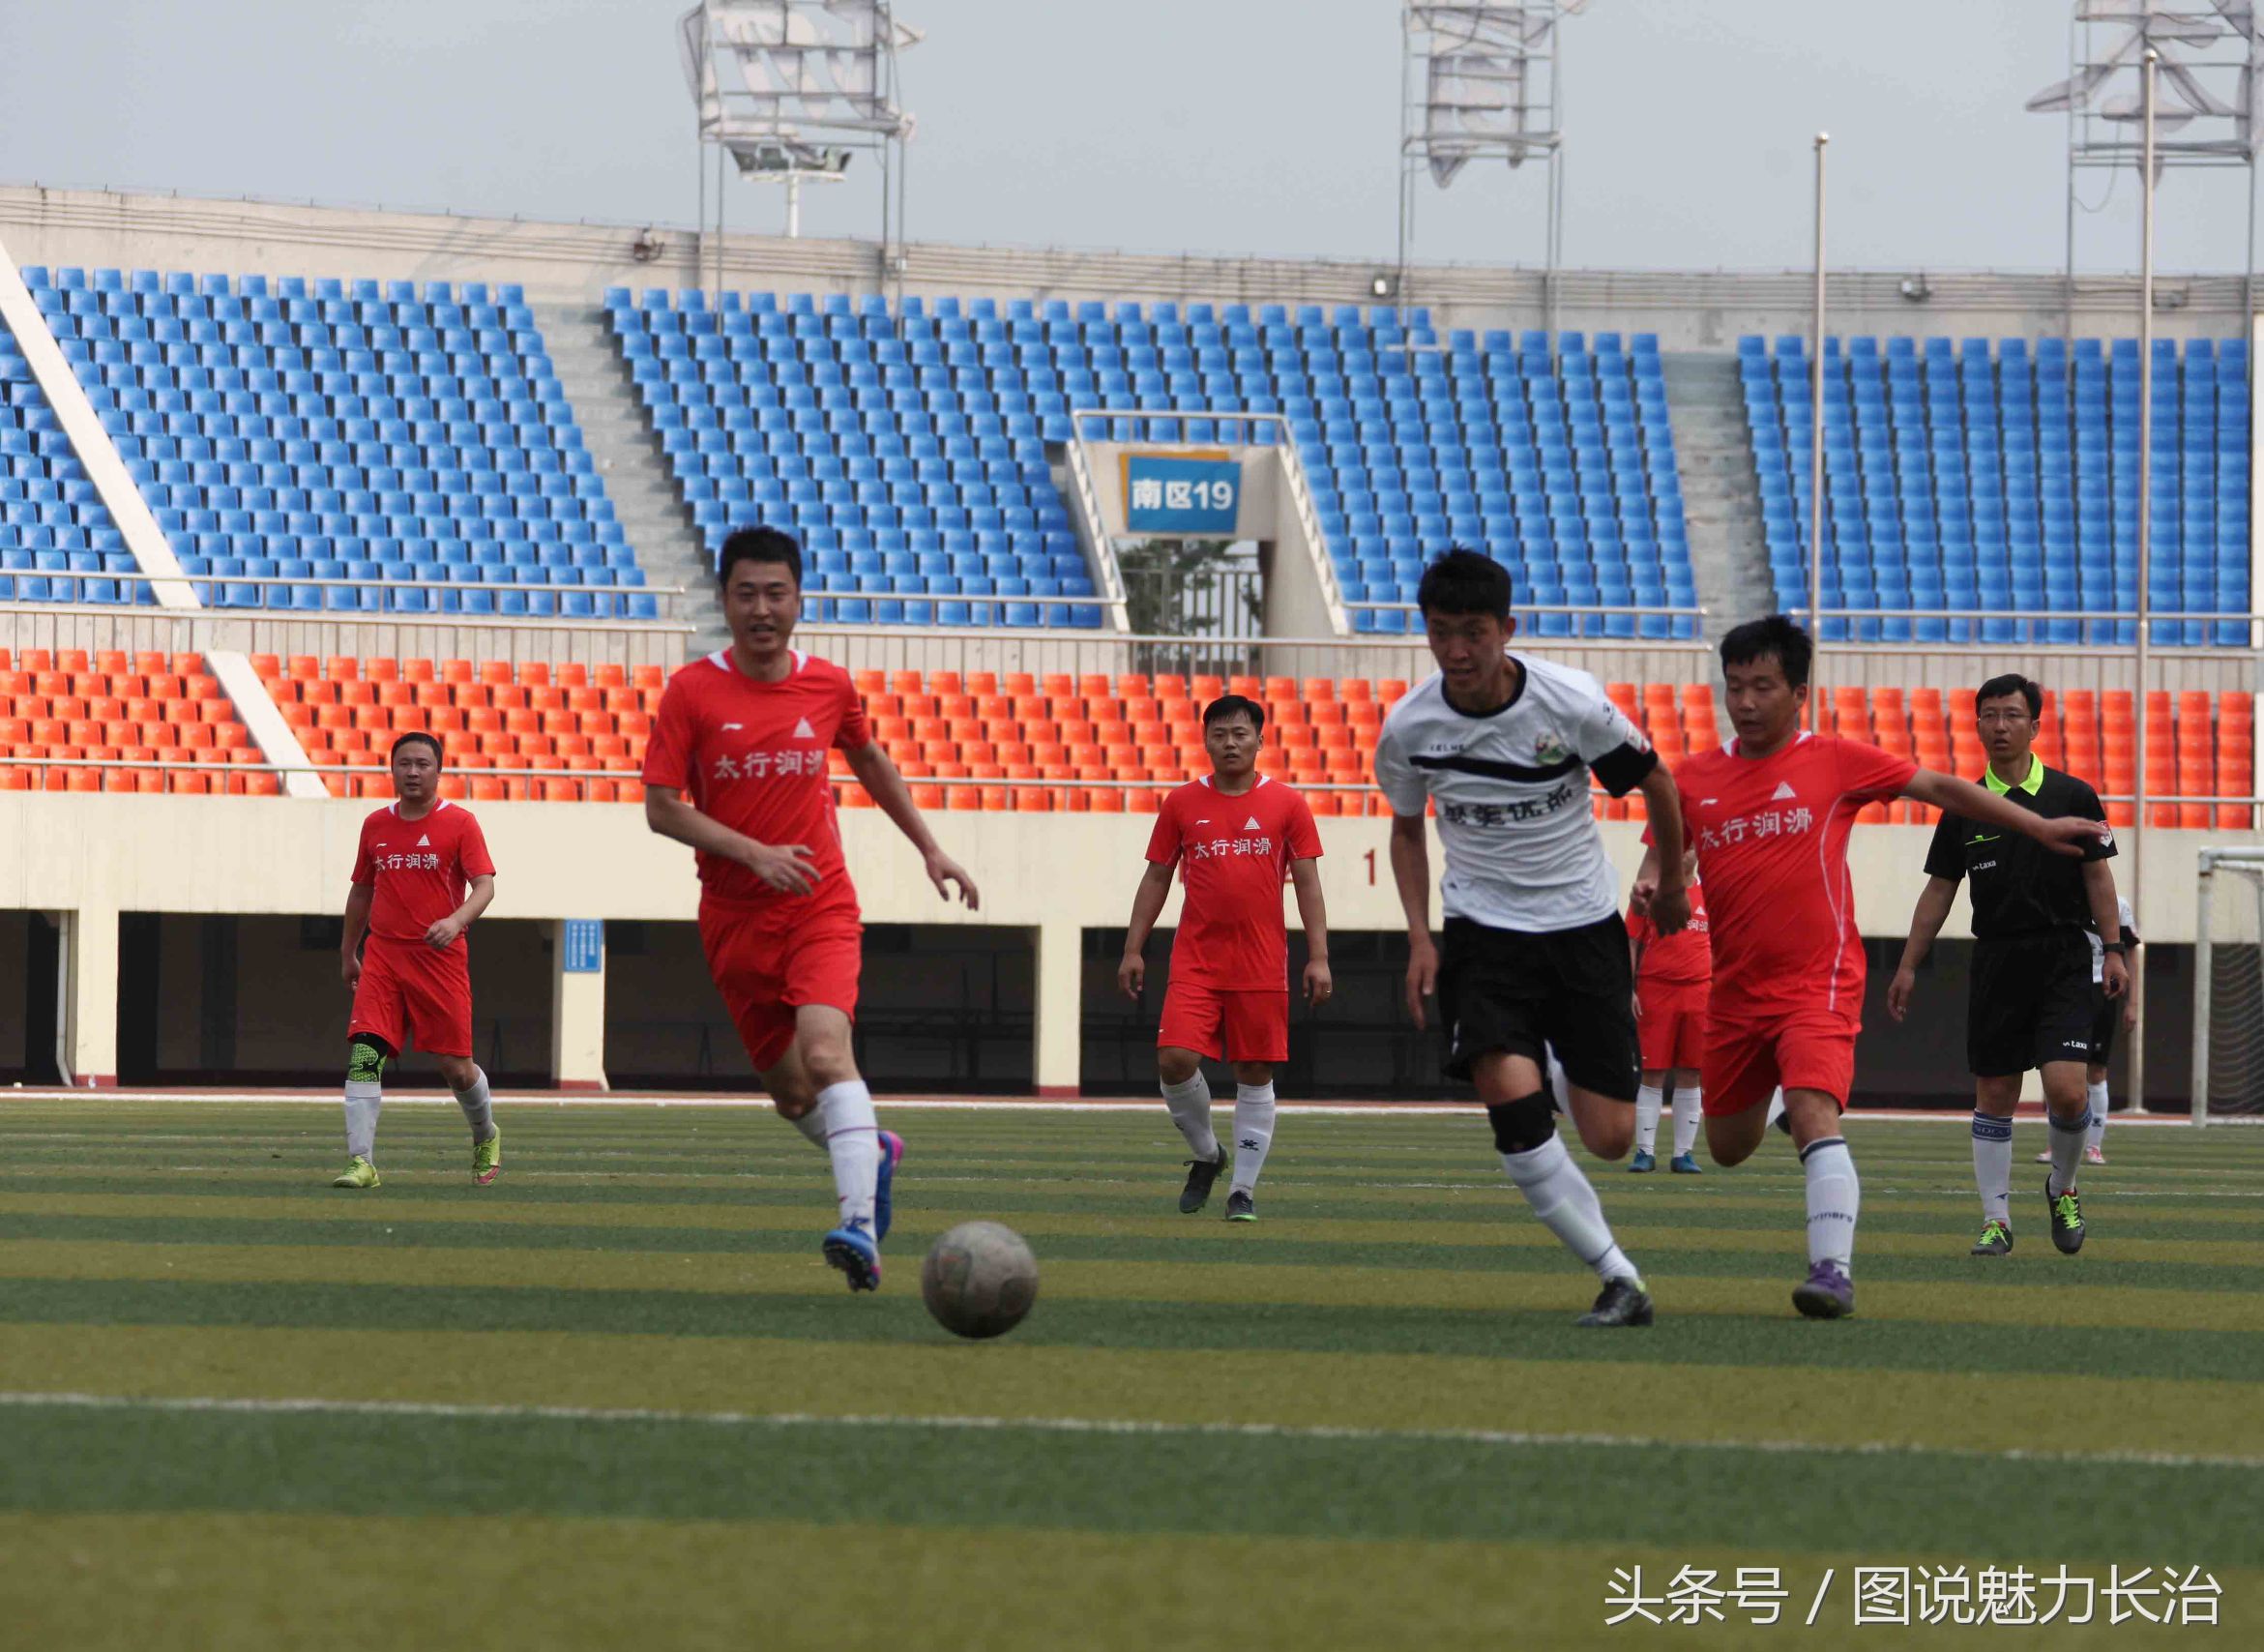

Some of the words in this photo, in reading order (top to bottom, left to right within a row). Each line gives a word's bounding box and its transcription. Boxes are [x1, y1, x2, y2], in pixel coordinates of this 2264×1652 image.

[1132, 478, 1233, 511] 南区19
[1701, 808, 1812, 850] 太行润滑
[374, 853, 439, 870] 太行润滑
[1194, 838, 1272, 859] 太行润滑
[1363, 848, 1375, 887] 1
